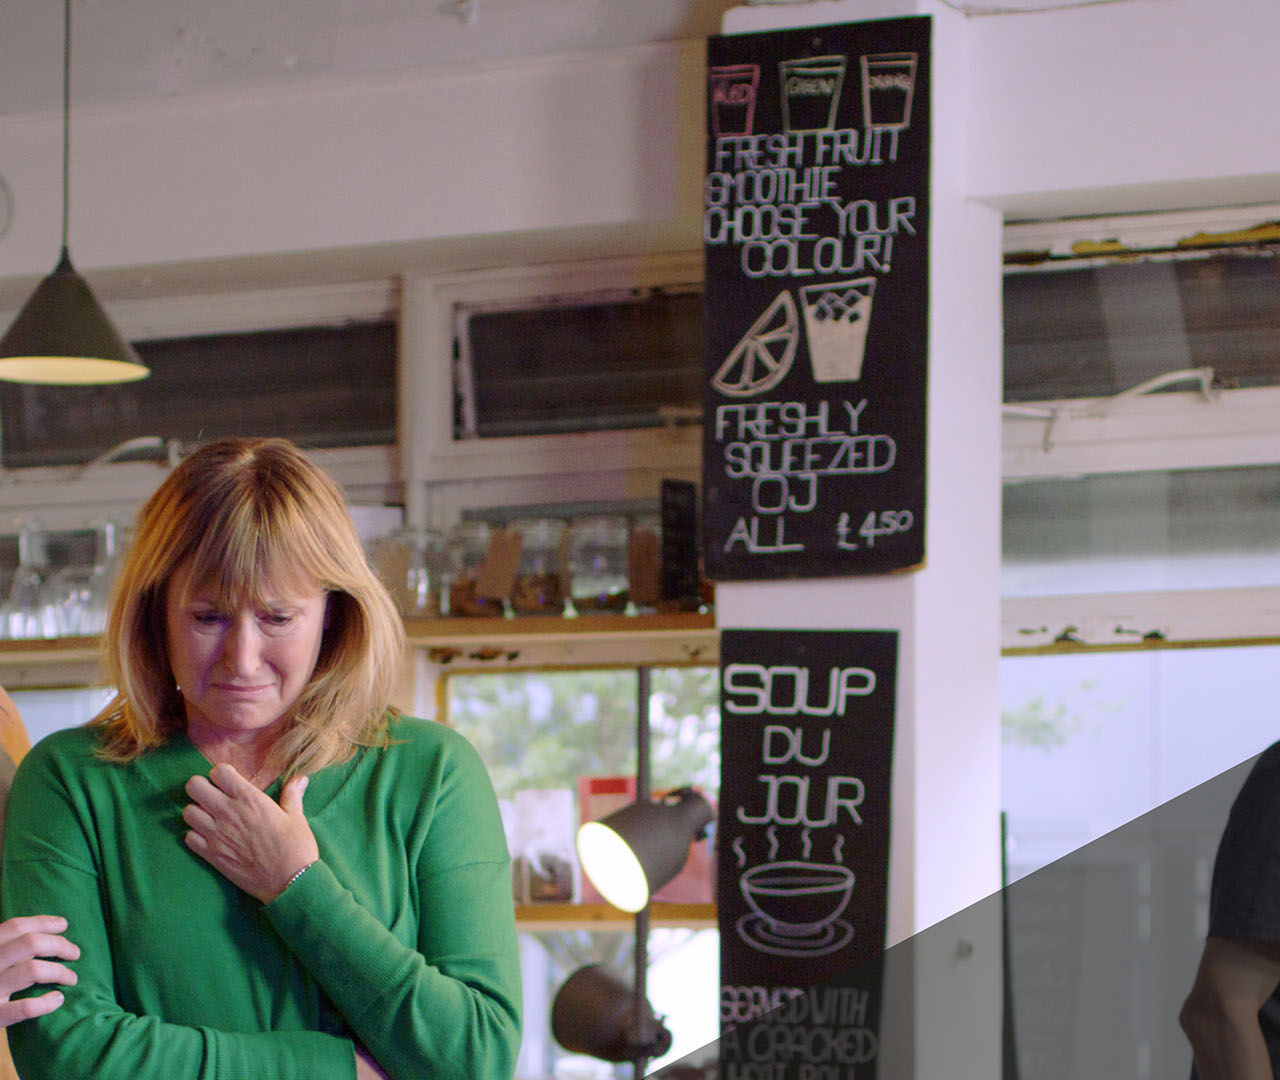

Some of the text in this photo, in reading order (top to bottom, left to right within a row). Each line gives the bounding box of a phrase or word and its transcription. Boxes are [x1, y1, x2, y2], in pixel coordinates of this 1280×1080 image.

[716, 127, 900, 171] FRESH FRUIT
[705, 165, 843, 208] SMOOTHIE
[704, 196, 917, 244] CHOOSE YOUR
[741, 234, 894, 278] COLOUR!
[716, 399, 868, 440] FRESHLY
[724, 434, 897, 478] SQUEEZED
[752, 471, 818, 514] OJ
[724, 516, 805, 554] ALL
[724, 662, 877, 717] SOUP
[762, 724, 831, 766] DU
[736, 774, 866, 828] JOUR
[720, 984, 809, 1025] SERVED
[721, 1023, 879, 1065] A CRACKED
